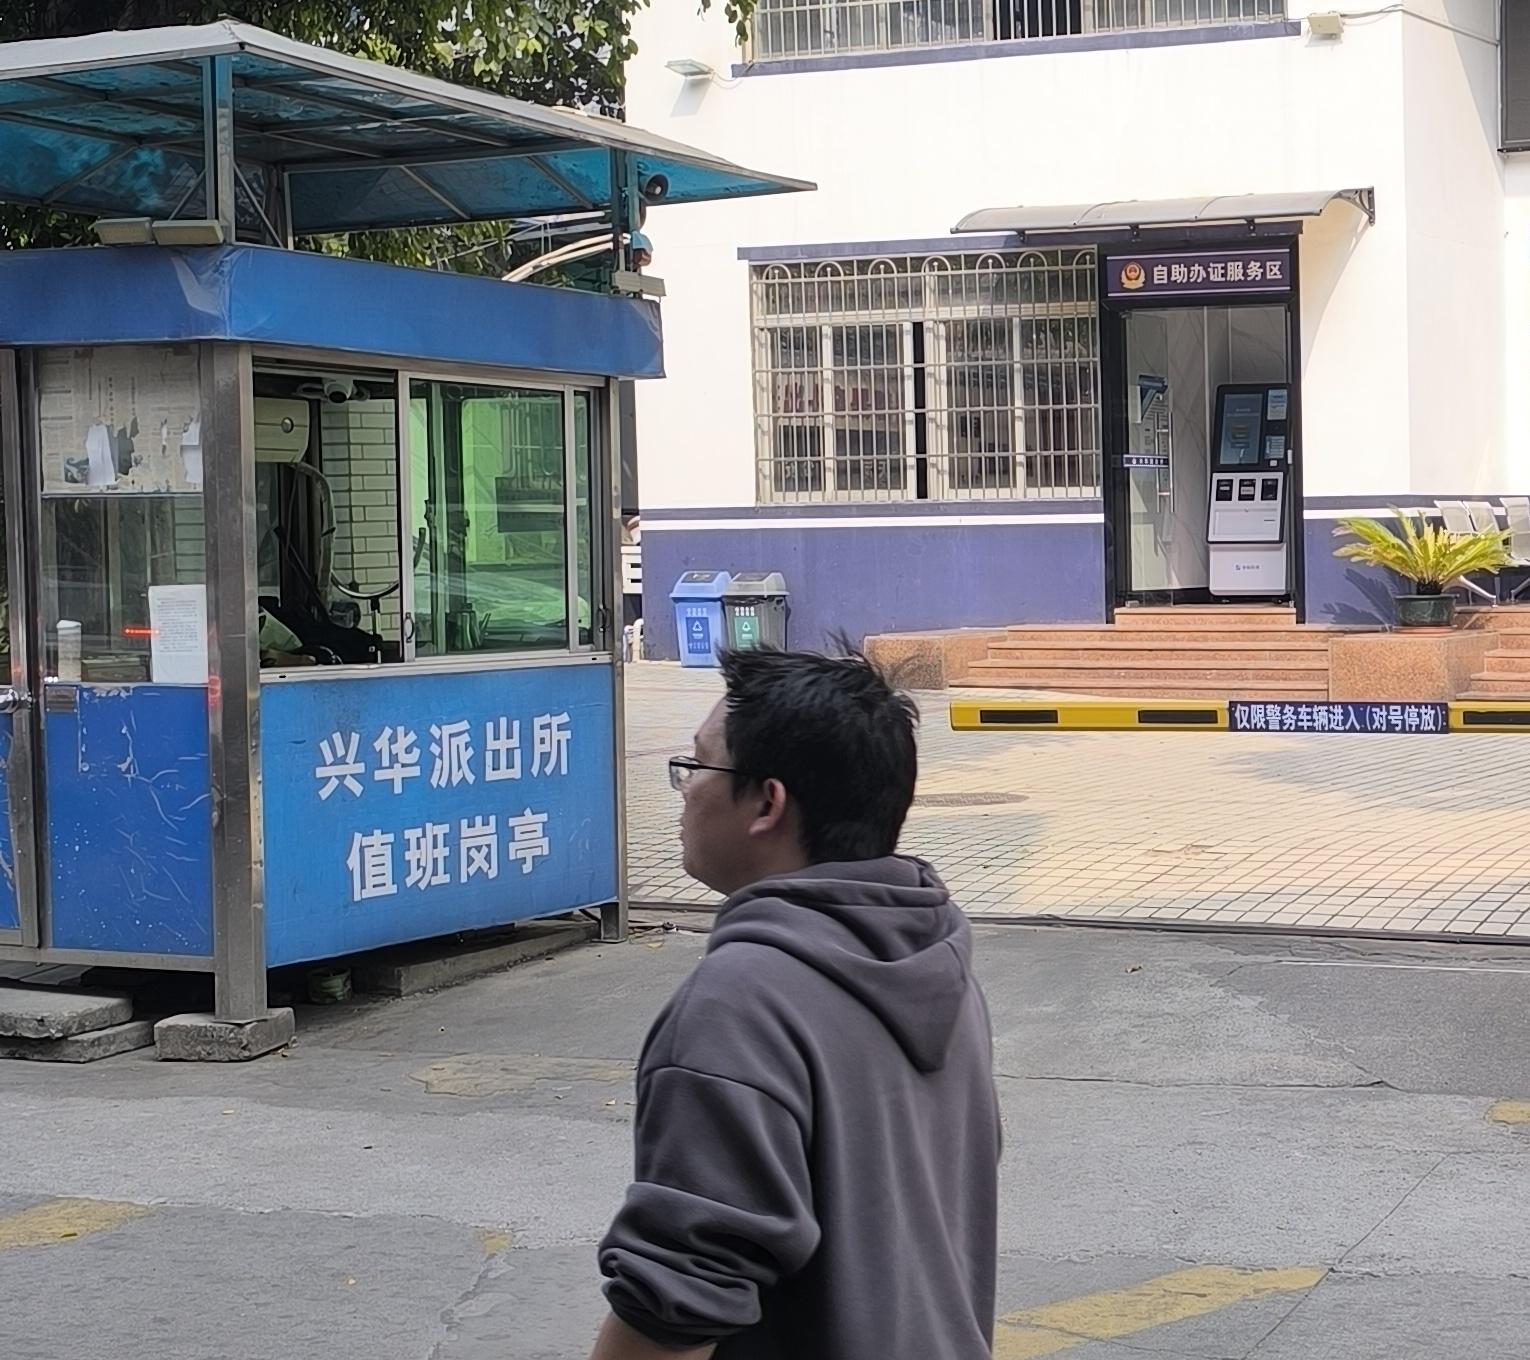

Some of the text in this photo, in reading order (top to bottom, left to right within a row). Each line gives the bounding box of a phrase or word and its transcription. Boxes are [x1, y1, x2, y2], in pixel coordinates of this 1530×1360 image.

[1153, 260, 1283, 285] 自助办证服务区
[315, 711, 572, 801] 兴华派出所
[346, 807, 550, 902] 值班岗亭
